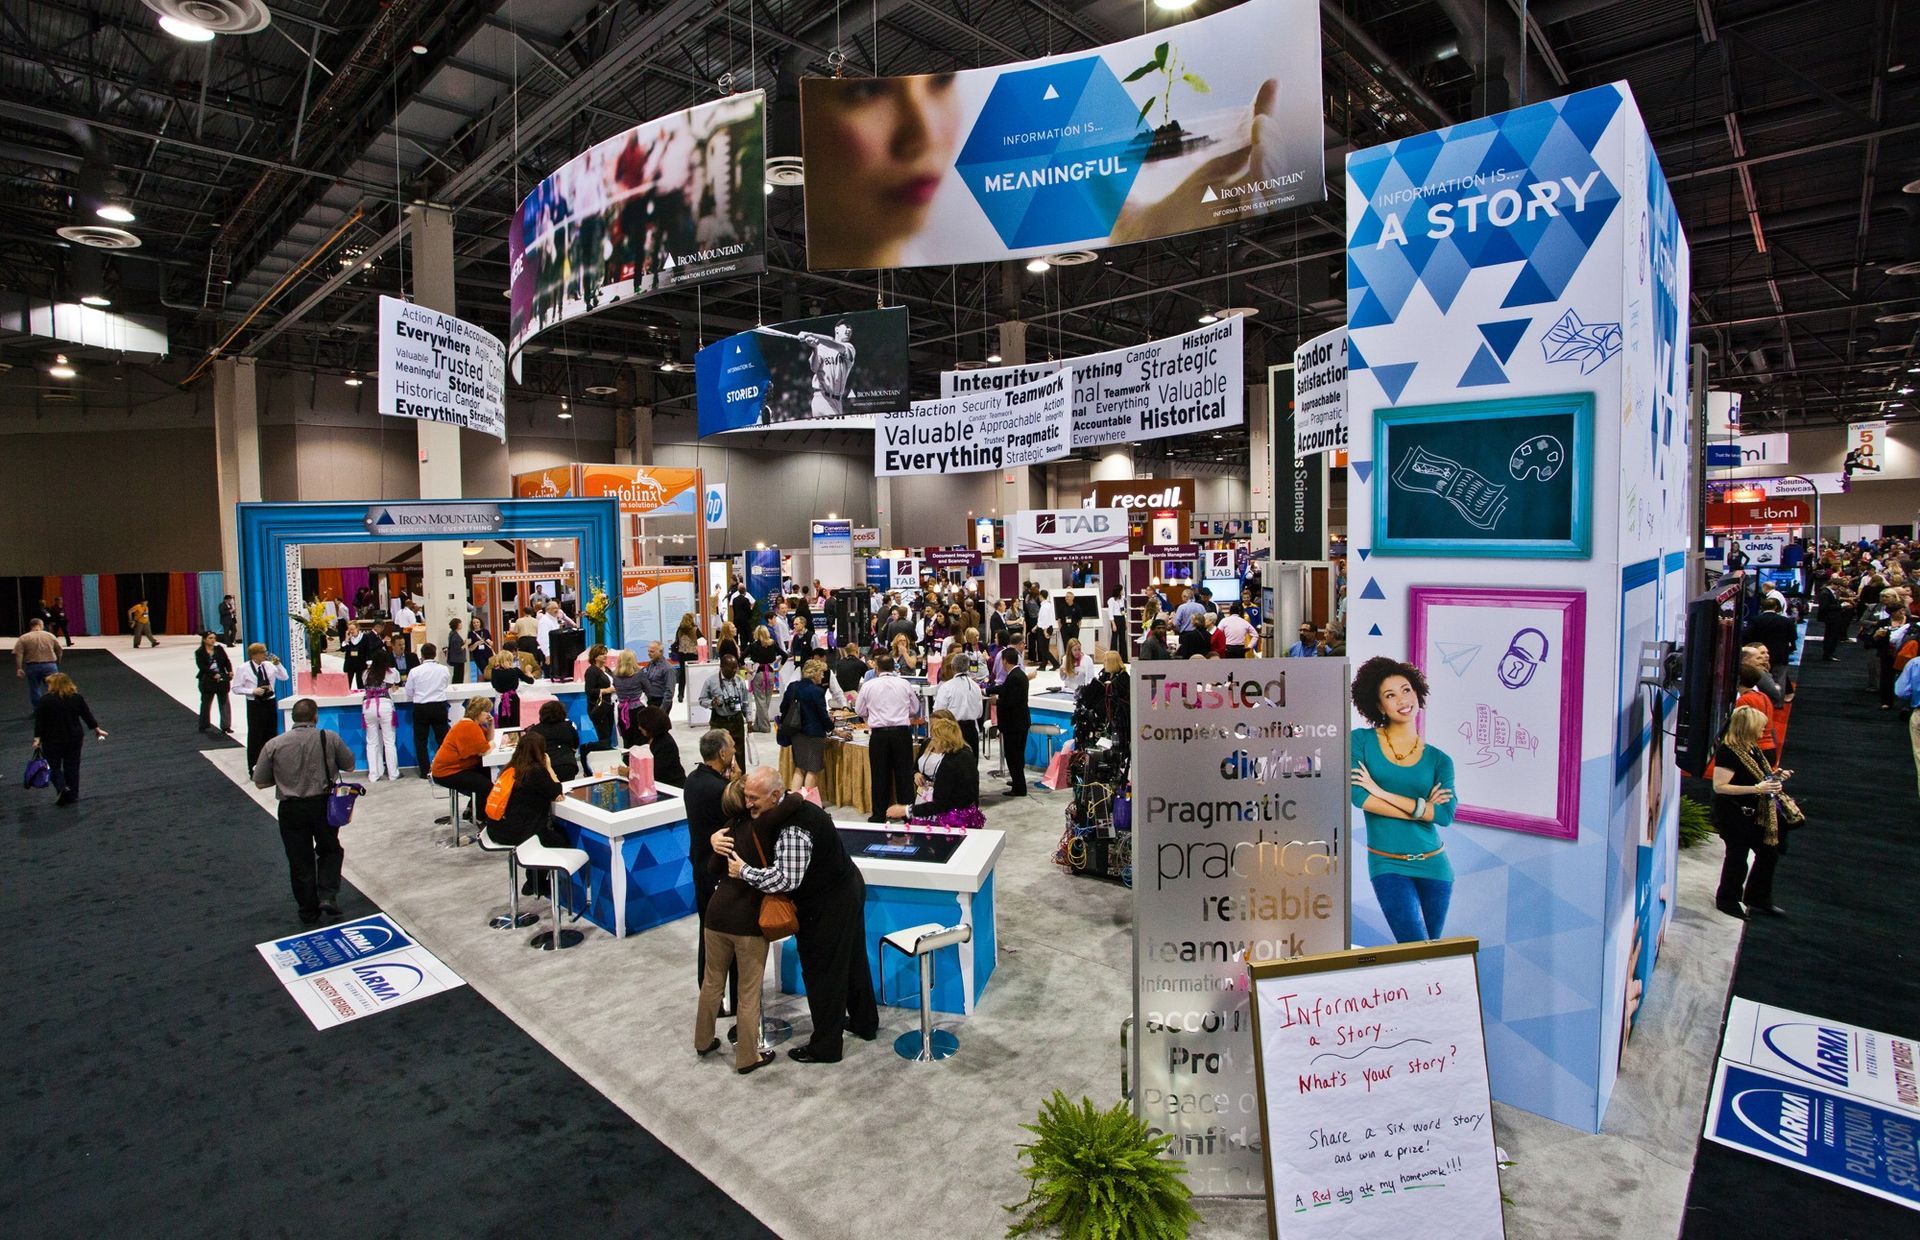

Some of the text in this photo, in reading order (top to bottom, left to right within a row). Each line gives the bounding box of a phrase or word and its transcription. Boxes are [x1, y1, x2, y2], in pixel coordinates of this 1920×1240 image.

[1003, 121, 1104, 146] INFORMATION IS...
[984, 155, 1128, 194] MEANINGFUL
[1219, 172, 1304, 200] IRON MOUNTAIN
[1378, 168, 1520, 209] INFORMATION IS...
[1212, 194, 1296, 218] INFORMATION IS EVERYTHING
[1375, 170, 1601, 250] A STORY
[677, 243, 744, 267] IRON MOUNTAIN
[670, 264, 736, 283] INFORMATION IS EVERYTHING
[402, 308, 432, 325] Action
[436, 314, 463, 335] Agile
[396, 320, 471, 355] Everywhere
[1126, 323, 1232, 364] Candor Historical
[396, 347, 429, 363] Valuable
[432, 348, 483, 382] Trusted
[396, 361, 441, 380] Meaningful
[1140, 346, 1218, 381] Strategic
[1297, 341, 1333, 374] Candor
[448, 376, 485, 399] Storied
[870, 388, 900, 398] MOUNTAIN
[953, 368, 1040, 392] Integrity
[962, 396, 1002, 412] Security
[1005, 375, 1065, 407] Teamwork
[1104, 372, 1227, 405] Teamwork Valuable
[396, 380, 480, 409] Historical Candor
[726, 385, 759, 404] STORIED
[989, 410, 1013, 418] Teamwork
[1043, 397, 1065, 413] Action
[1096, 396, 1150, 414] Everything
[1301, 391, 1341, 413] Approachable
[396, 398, 468, 427] Everything
[469, 409, 495, 426] Strategic
[1073, 395, 1226, 431] Accountable Historical
[1310, 407, 1343, 425] Pragmatic
[885, 420, 974, 446] Valuable
[979, 411, 1042, 435] Approachable
[984, 424, 1060, 448] Trusted Pragmatic
[1073, 429, 1126, 445] Everywhere
[1297, 424, 1348, 454] Accounta
[885, 443, 1063, 473] Everything Strategic Security
[1741, 442, 1766, 461] ml
[603, 485, 658, 502] infolinx
[1777, 478, 1814, 486] Solutions
[627, 501, 658, 509] solutions
[706, 493, 720, 514] hp
[1111, 486, 1180, 508] recall
[1294, 470, 1308, 533] Sciences
[399, 514, 490, 525] IRON MOUNTAIN
[1059, 515, 1110, 534] TAB
[1763, 506, 1797, 519] ibml
[443, 525, 493, 533] EVERYTHING
[956, 552, 975, 560] Imaging
[895, 578, 916, 586] TAB
[1210, 569, 1231, 577] TAB
[1141, 670, 1286, 711] Trusted
[1140, 719, 1338, 744] Complete Confidence
[1219, 747, 1322, 785] digital
[1146, 793, 1297, 829] Pragmatic
[1157, 827, 1338, 891] practical
[1203, 886, 1333, 922] reliable
[308, 934, 344, 964] PLATINUM
[341, 927, 376, 954] ARMA
[1149, 935, 1304, 964] teamwork
[290, 940, 323, 970] SPONSOR
[312, 976, 356, 1018] INDUSTRY MEMBER
[353, 967, 401, 1002] ARMA
[1141, 974, 1234, 993] Information
[1426, 981, 1443, 997] is
[1145, 1009, 1249, 1034] accou
[1309, 1035, 1321, 1047] a
[1298, 1070, 1347, 1095] What's
[1408, 1045, 1457, 1072] story?
[1814, 1027, 1849, 1087] ARMA
[1144, 1088, 1255, 1114] Peace o
[1308, 1112, 1485, 1150] Share a six word story
[1779, 1091, 1810, 1157] ARMA
[1823, 1098, 1835, 1147] INTERNATIONAL
[1334, 1139, 1431, 1164] and win a prize!
[1844, 1106, 1877, 1178] PLATINUM
[1882, 1119, 1920, 1191] SPONSOR
[1294, 1193, 1304, 1208] A
[1312, 1189, 1331, 1203] Red
[1336, 1187, 1353, 1205] dog
[1359, 1183, 1375, 1197] ate
[1379, 1181, 1395, 1194] my
